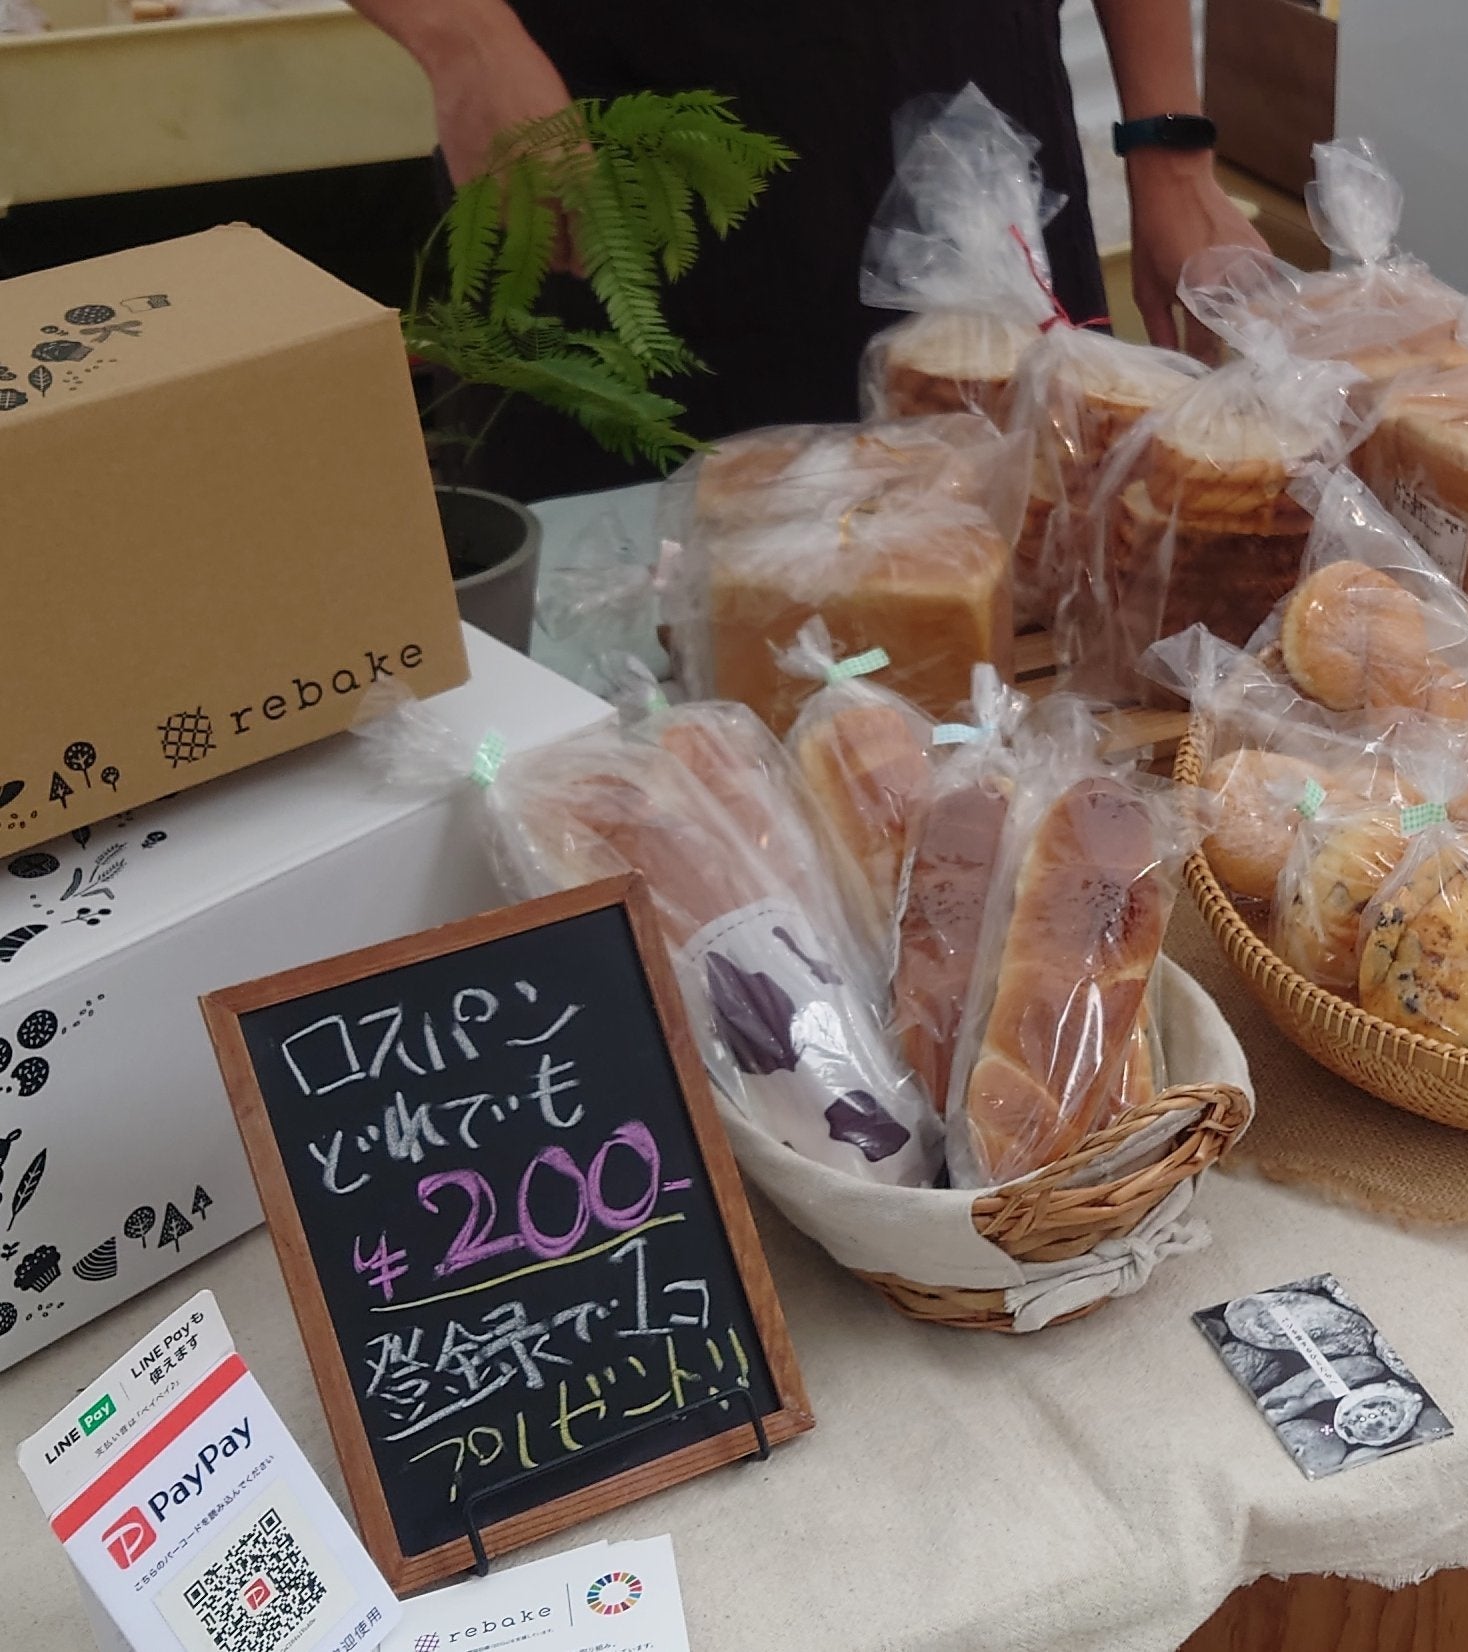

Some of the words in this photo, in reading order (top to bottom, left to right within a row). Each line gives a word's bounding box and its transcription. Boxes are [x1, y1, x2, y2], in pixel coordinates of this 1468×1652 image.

[229, 643, 424, 736] rebake
[281, 979, 584, 1096] ロスパン
[308, 1052, 584, 1196] どれでも
[130, 1344, 164, 1378] LINE
[163, 1311, 204, 1349] Payも
[149, 1333, 201, 1386] 使えます
[44, 1427, 82, 1465] LINE
[84, 1401, 110, 1429] Pay
[146, 1415, 257, 1523] PayPay
[133, 1454, 276, 1592] こちらのバーコードを読み込んでください
[332, 1606, 383, 1652] 迎使用
[448, 1604, 553, 1645] rebake
